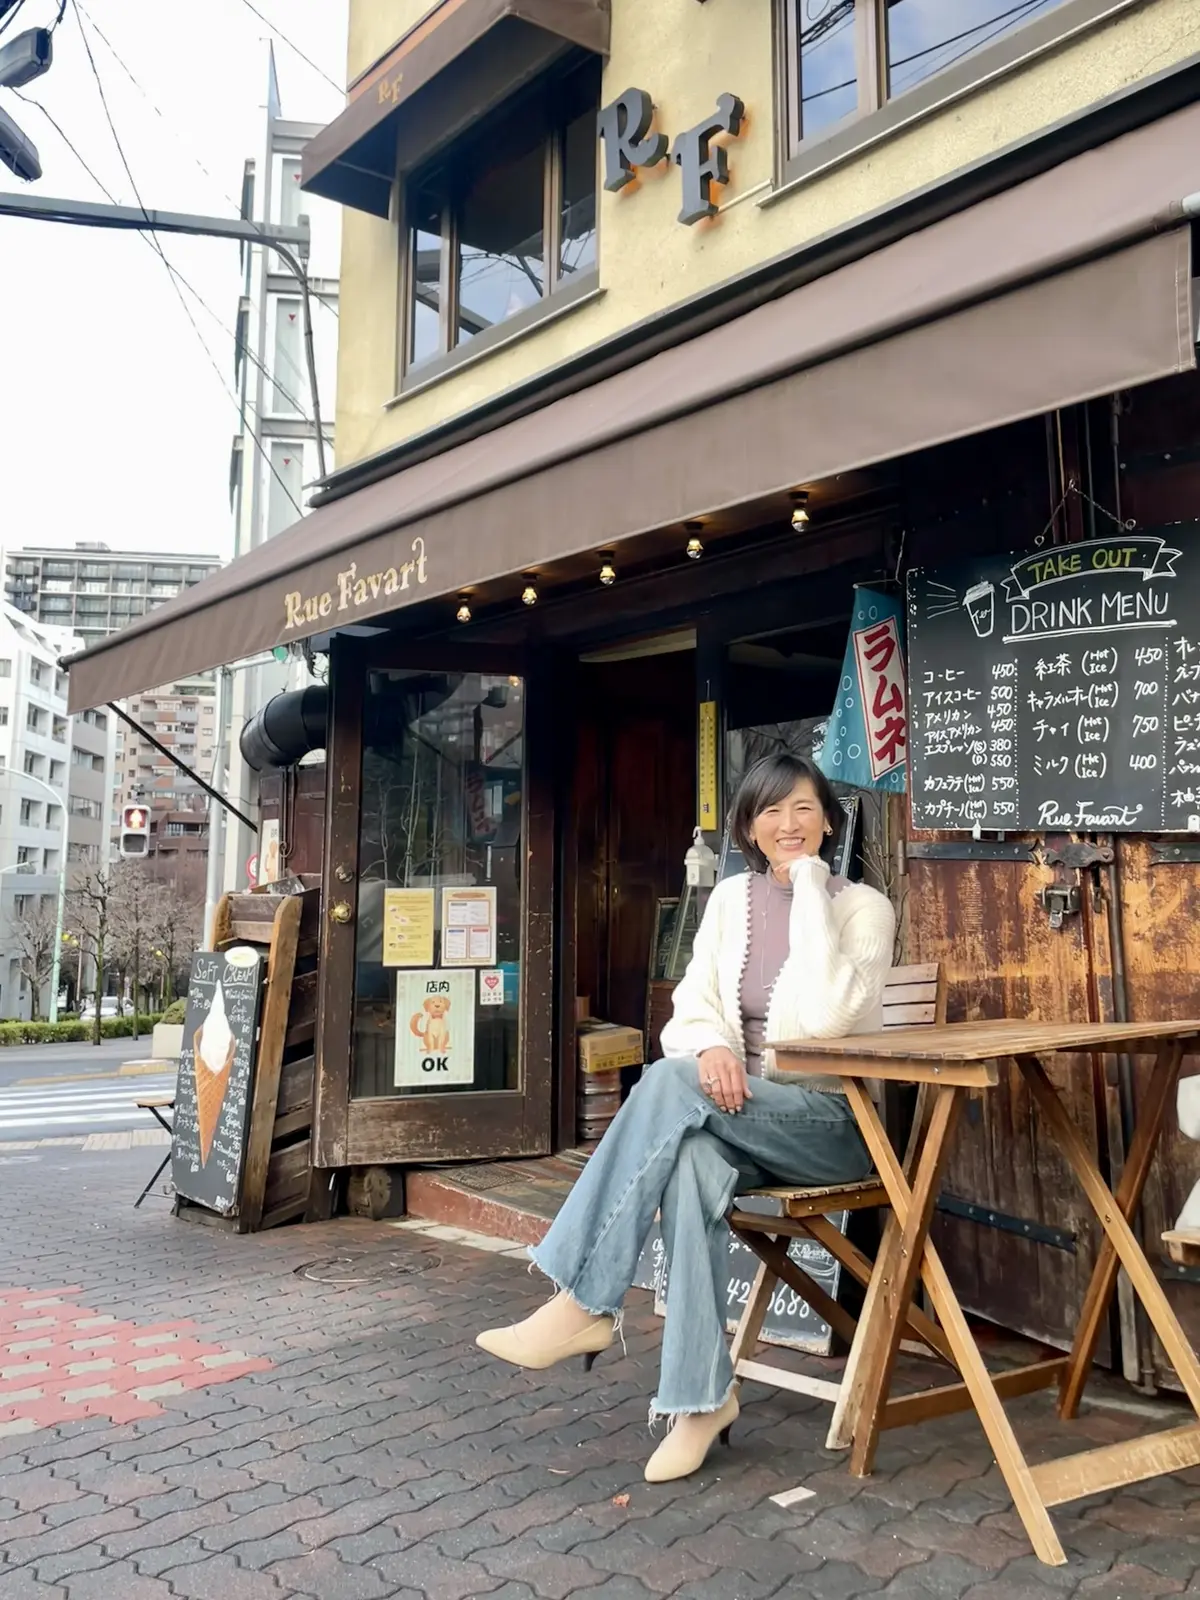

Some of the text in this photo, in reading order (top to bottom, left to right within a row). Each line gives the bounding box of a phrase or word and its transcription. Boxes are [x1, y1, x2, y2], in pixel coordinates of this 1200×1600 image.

[1027, 547, 1137, 585] TAKE OUT
[284, 536, 428, 629] Rue Favart
[1011, 588, 1168, 634] DRINK MENU
[923, 663, 1014, 684] コーヒー 450
[1034, 653, 1072, 681] 紅茶
[1134, 647, 1163, 666] 450
[863, 624, 906, 765] ラムネ
[922, 686, 1013, 707] アイスコーヒー 500
[1027, 686, 1088, 712] キャラメルオレ
[1134, 680, 1158, 700] 700
[924, 702, 1012, 729] アメリカン 450
[1032, 719, 1069, 742] チャイ
[1132, 714, 1159, 738] 750
[923, 718, 1014, 744] アイスアメリカン 450
[989, 738, 1012, 751] 380
[989, 754, 1012, 767] 550
[1033, 755, 1069, 776] ミルク
[1129, 754, 1157, 770] 400
[923, 775, 963, 792] カフェラテ
[991, 776, 1015, 791] 550
[924, 799, 965, 818] カプチーノ
[993, 801, 1015, 815] 550
[1038, 800, 1073, 826] Rue
[426, 980, 450, 993] 店内
[421, 1056, 449, 1072] OK
